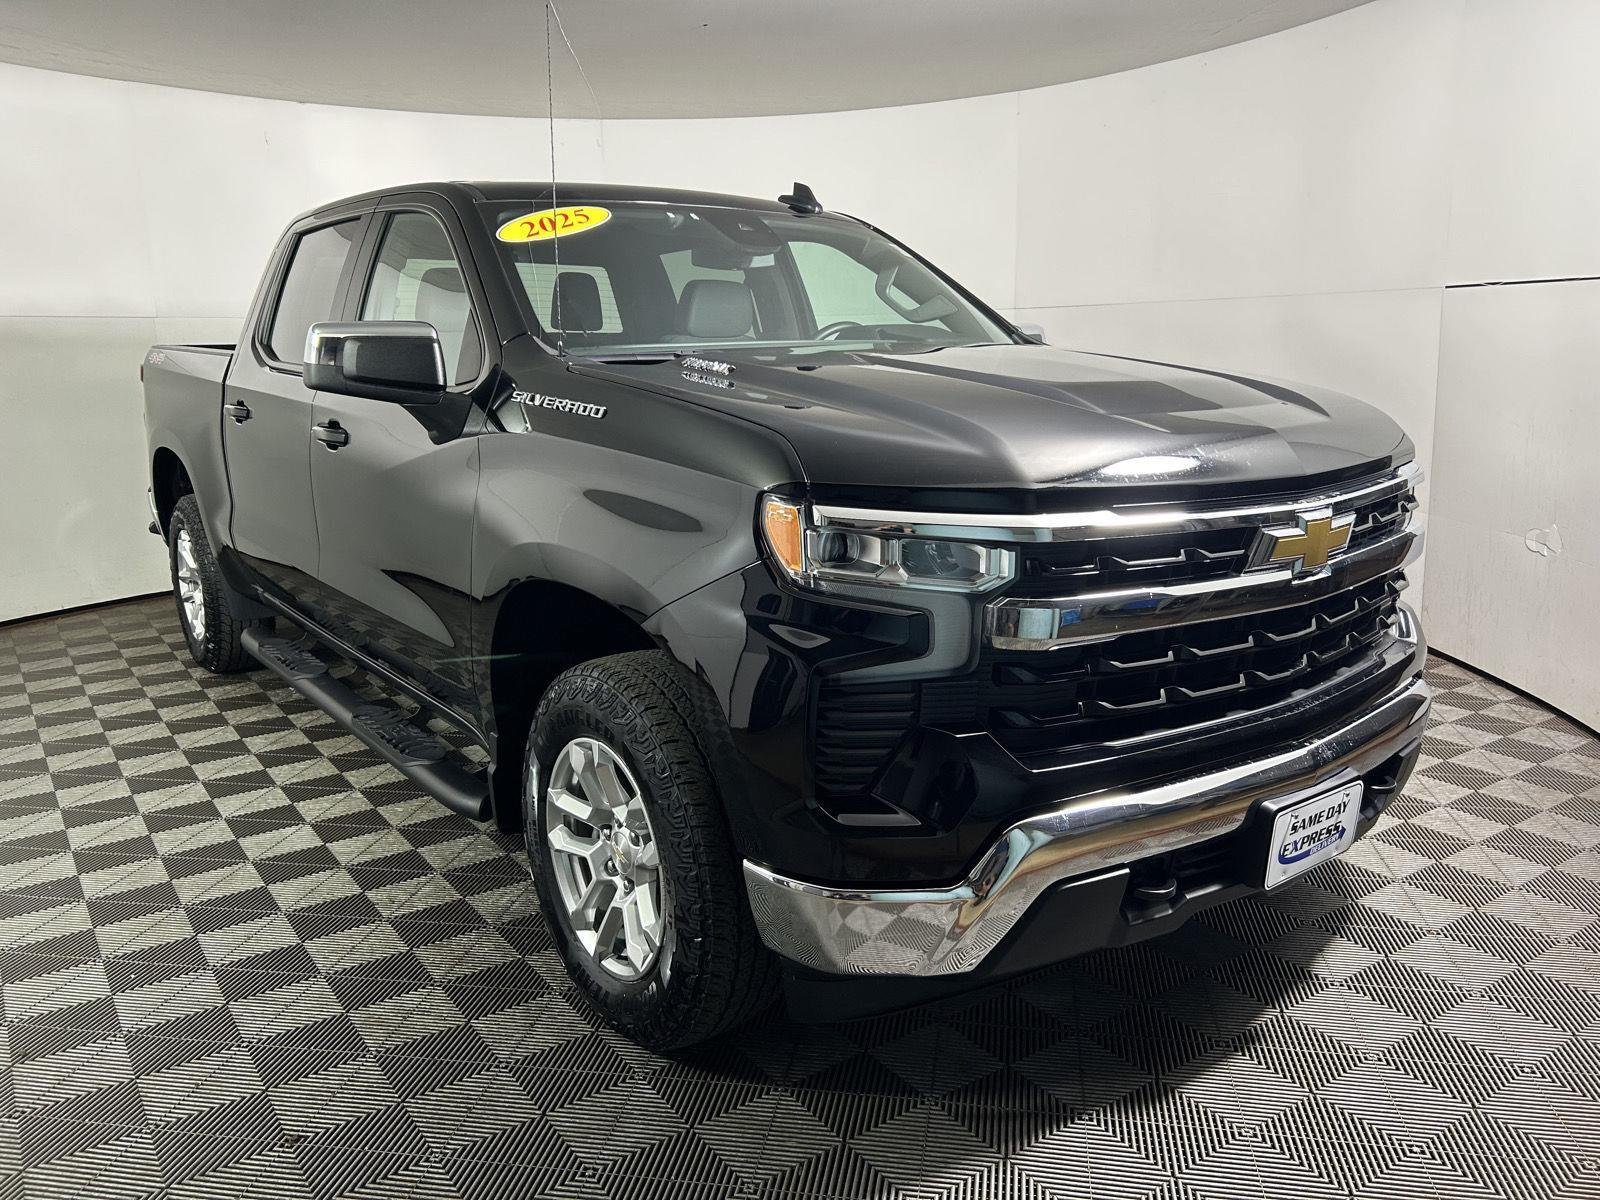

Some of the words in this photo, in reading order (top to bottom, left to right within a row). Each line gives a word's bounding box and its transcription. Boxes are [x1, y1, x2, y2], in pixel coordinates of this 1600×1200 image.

[520, 208, 590, 238] 2025
[511, 391, 607, 418] SILVERADO
[1289, 810, 1326, 836] SAME
[1325, 799, 1351, 821] DAY
[1282, 821, 1342, 856] EXPRESS
